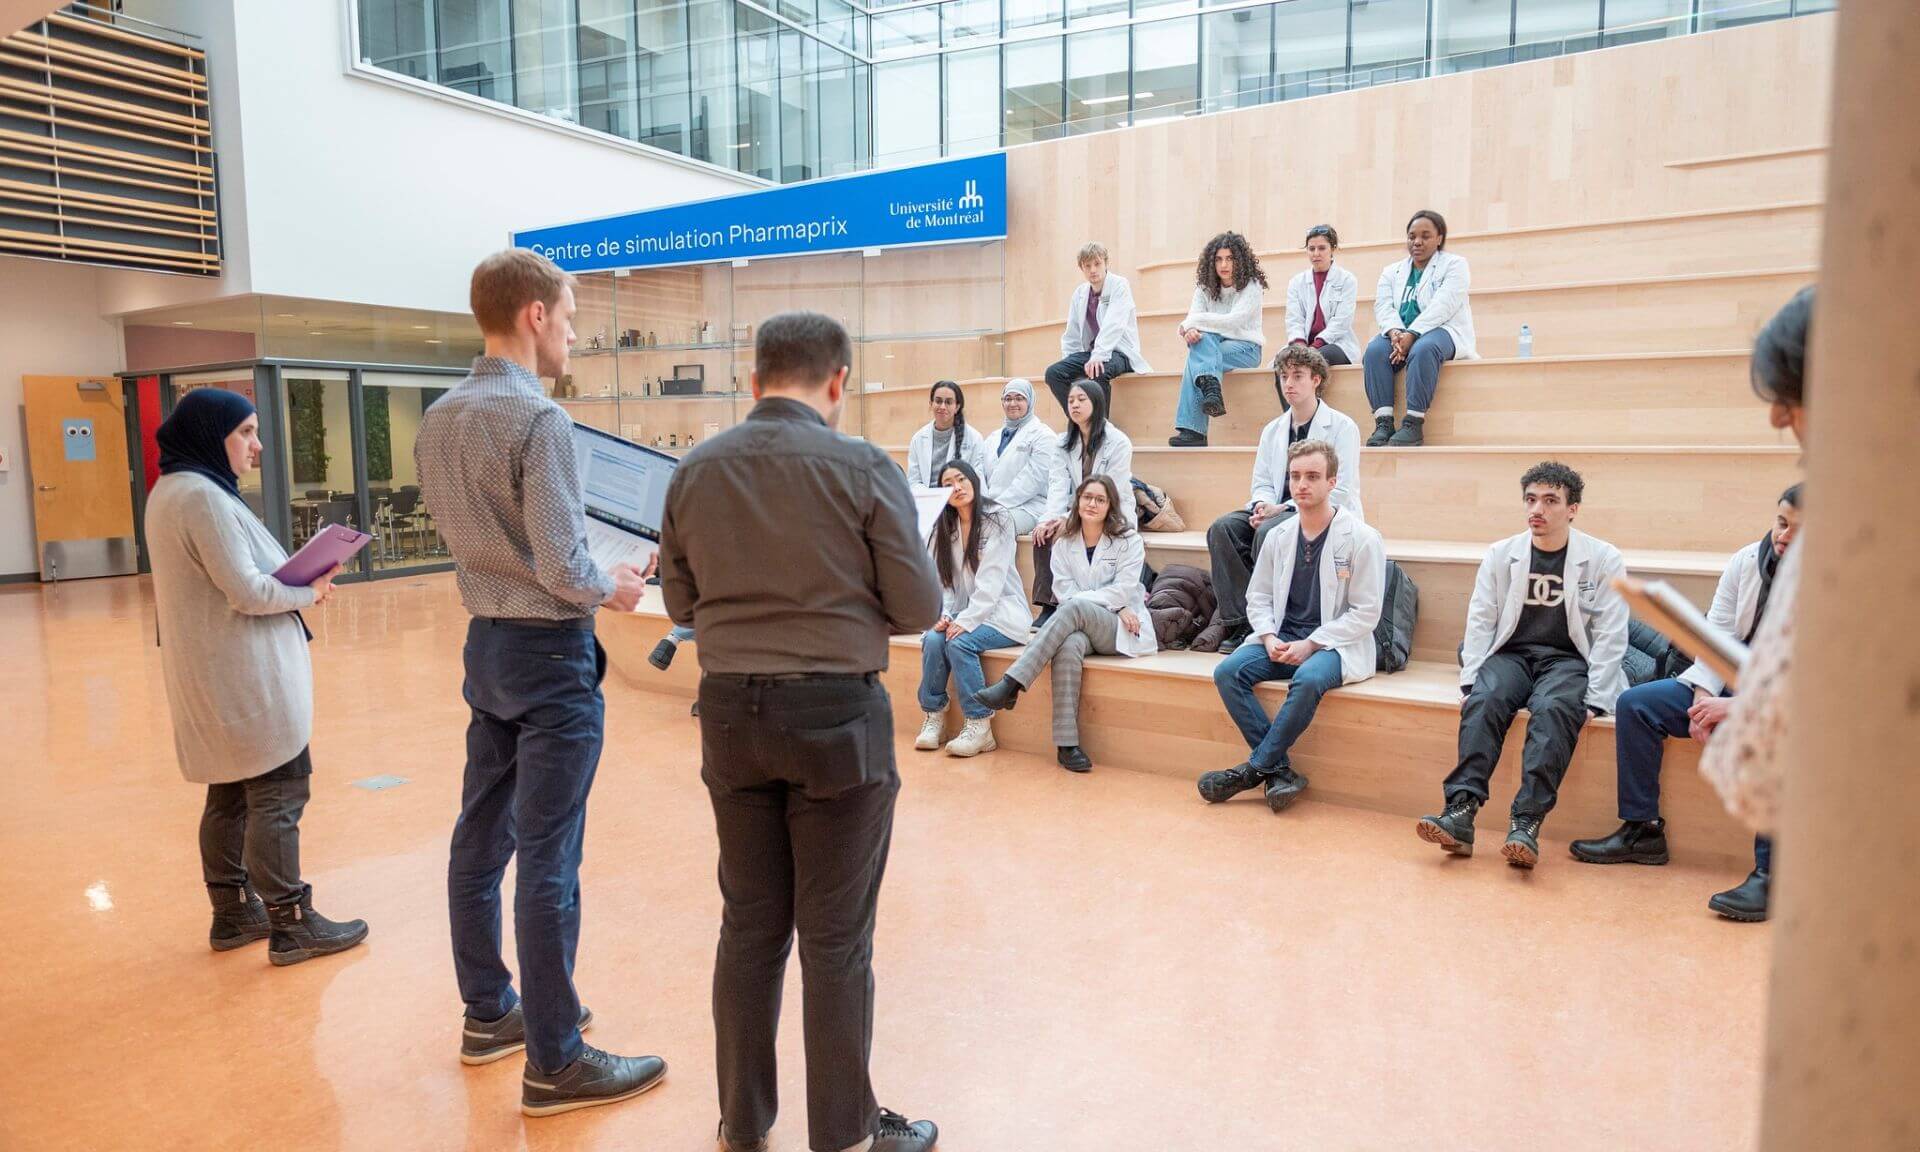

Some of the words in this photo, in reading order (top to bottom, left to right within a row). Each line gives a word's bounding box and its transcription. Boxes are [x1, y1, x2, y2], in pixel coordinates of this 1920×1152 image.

[889, 198, 953, 216] Université
[906, 215, 922, 229] de
[924, 209, 984, 228] Montréal
[596, 237, 620, 257] de
[625, 228, 723, 255] simulation
[729, 215, 848, 244] Pharmaprix
